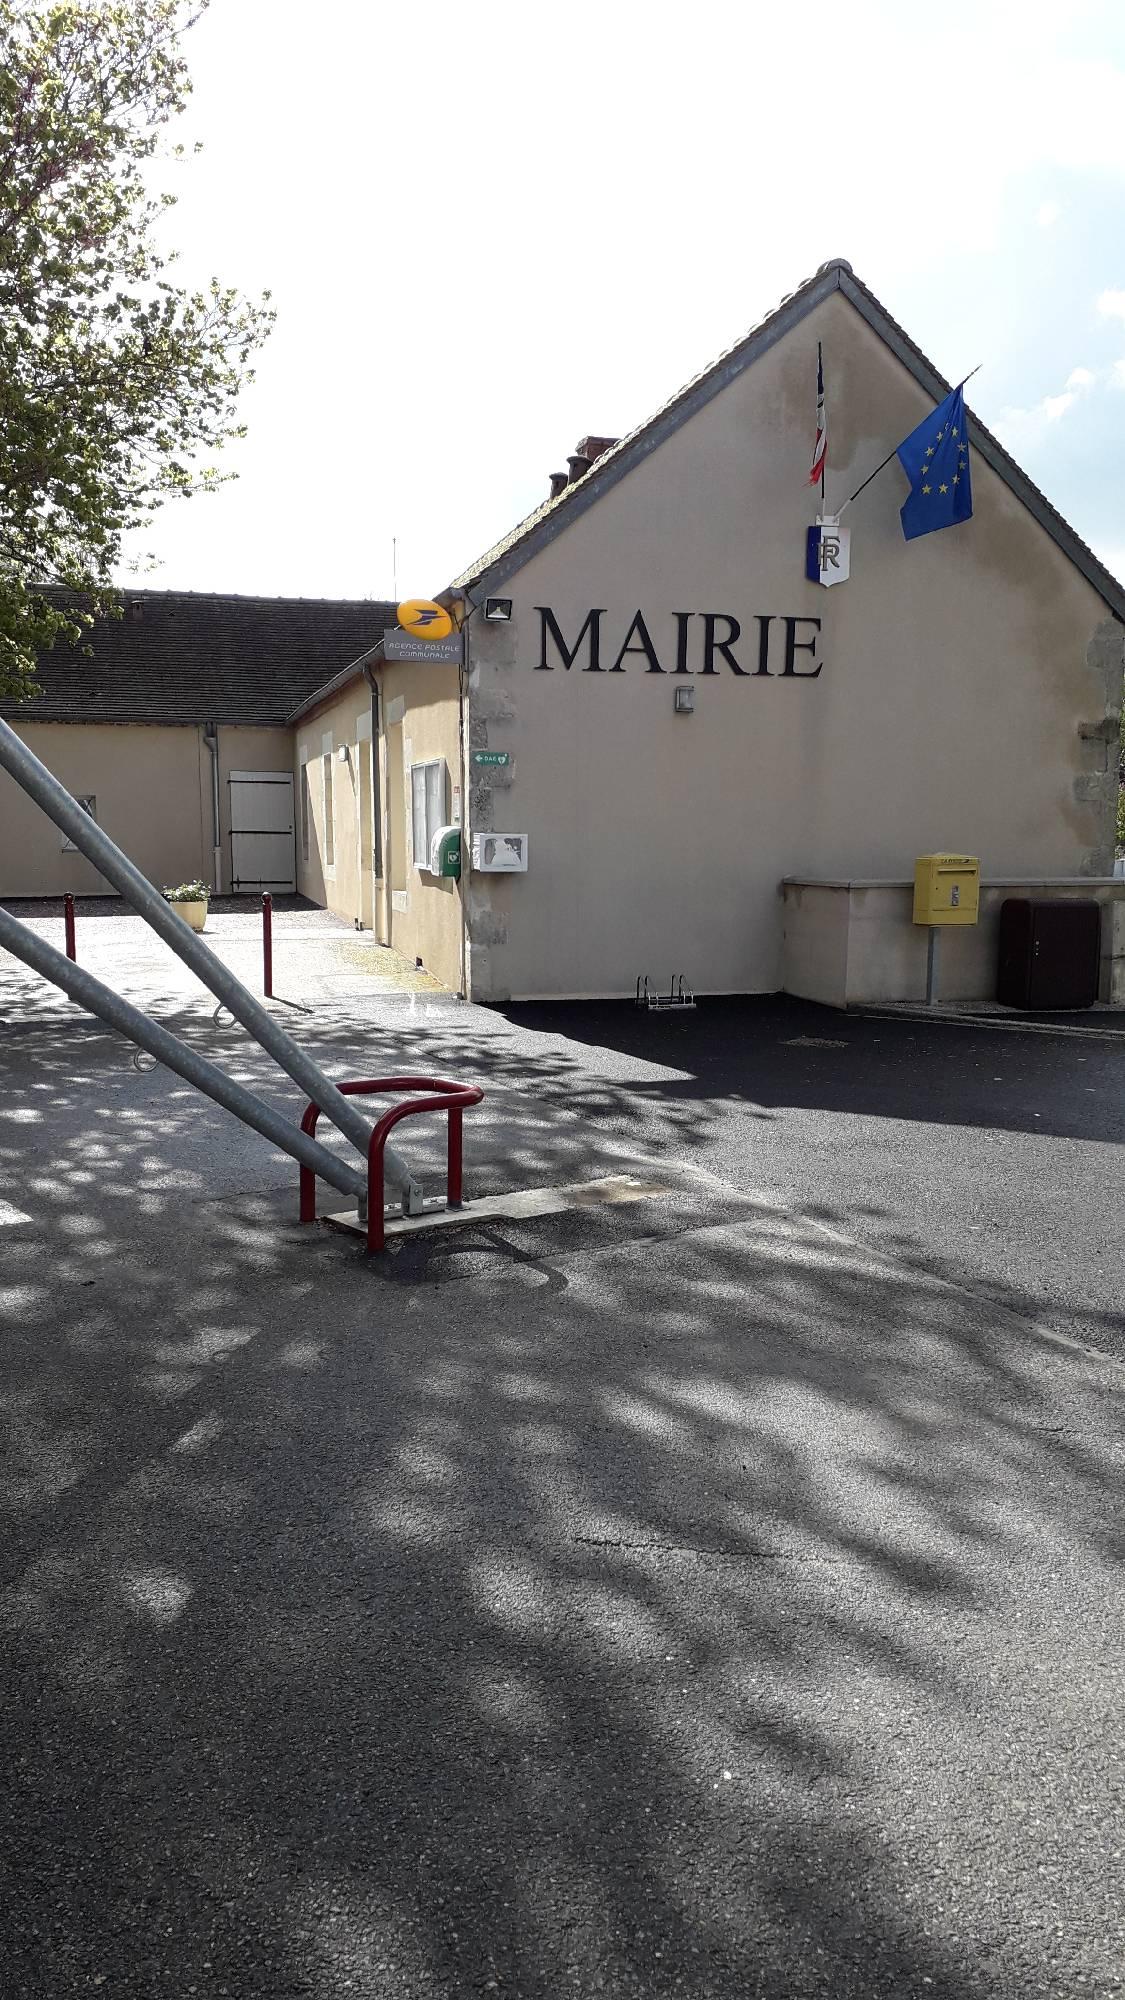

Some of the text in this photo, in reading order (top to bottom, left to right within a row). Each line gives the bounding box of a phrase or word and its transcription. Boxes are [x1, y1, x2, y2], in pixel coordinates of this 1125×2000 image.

[388, 642, 460, 652] AGENCE POSTALE
[532, 606, 824, 678] MAIRIE
[399, 651, 451, 659] COMMUNALE
